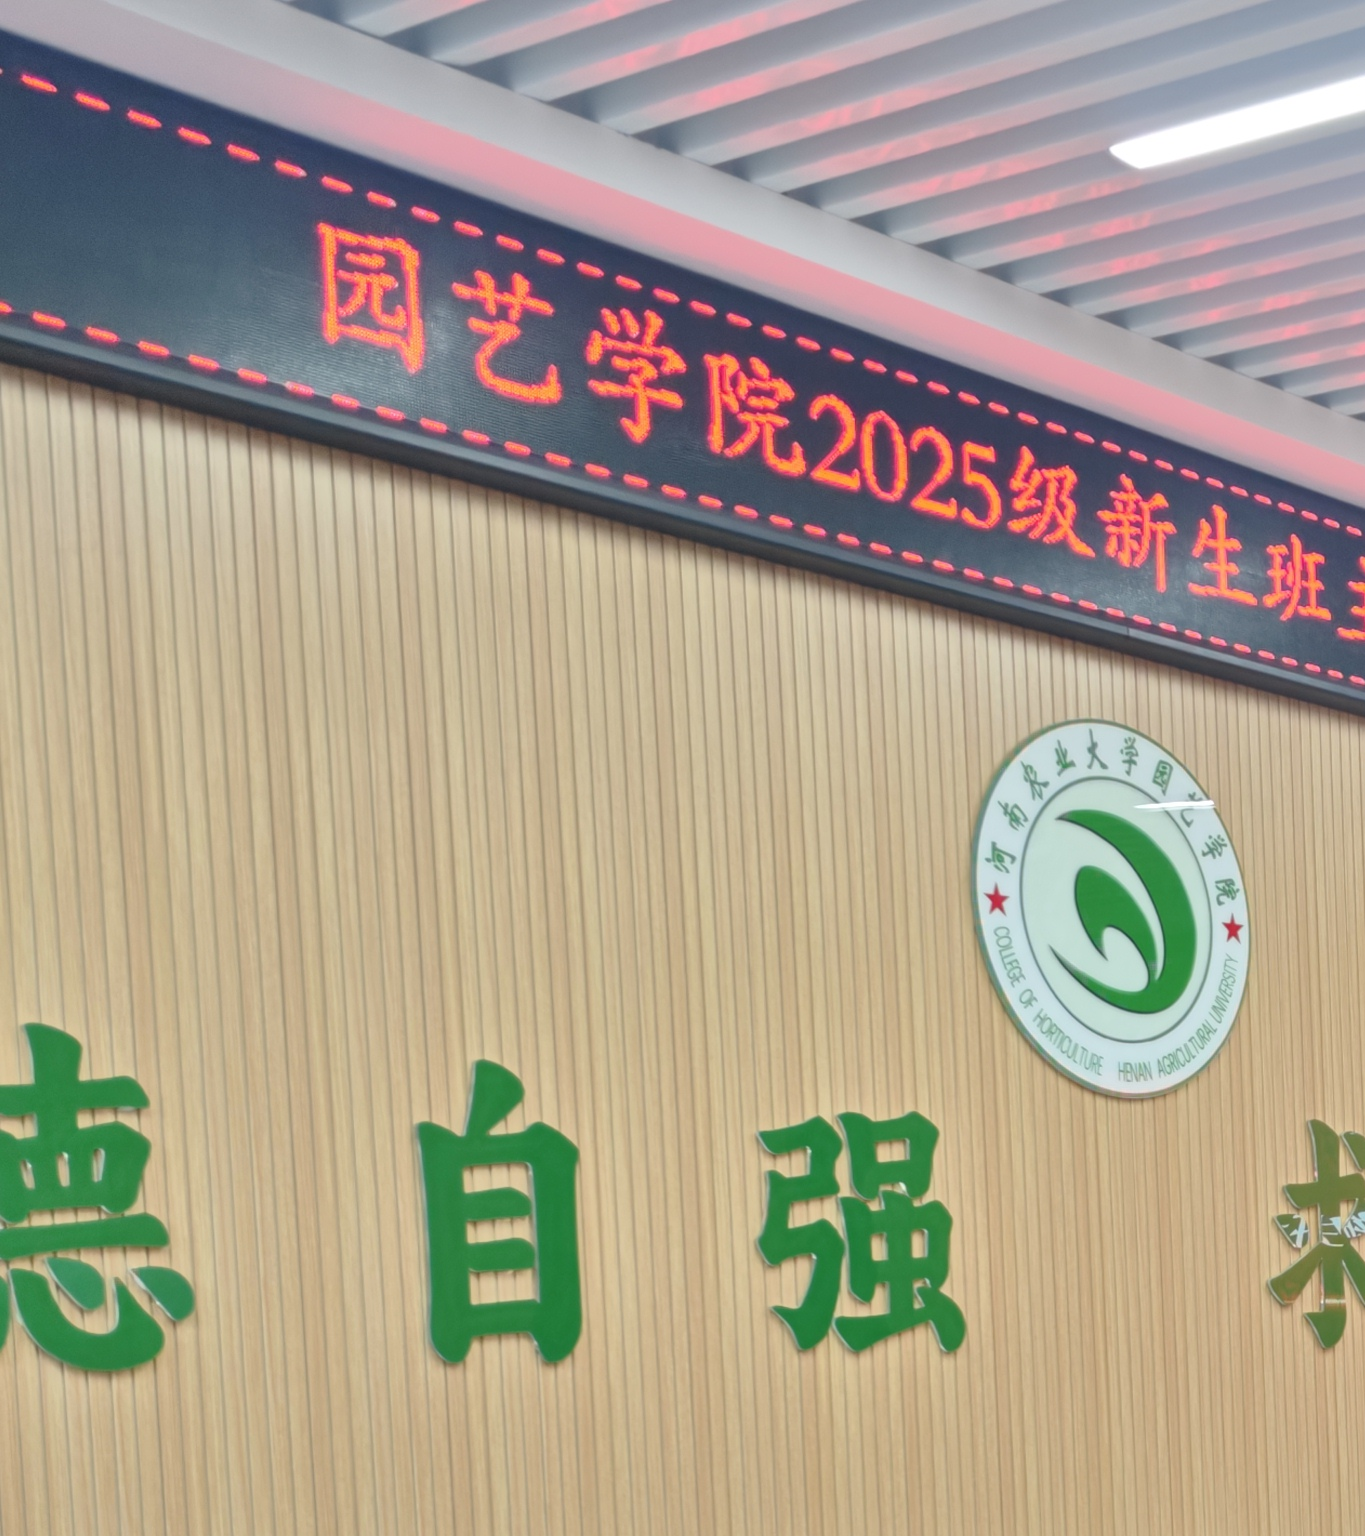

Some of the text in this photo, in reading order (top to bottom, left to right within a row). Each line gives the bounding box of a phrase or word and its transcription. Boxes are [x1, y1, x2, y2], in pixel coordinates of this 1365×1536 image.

[993, 926, 1239, 1083] COLLEGE OF HORTICULTURE HENAN AGRICULTURAL UNIVERSITY
